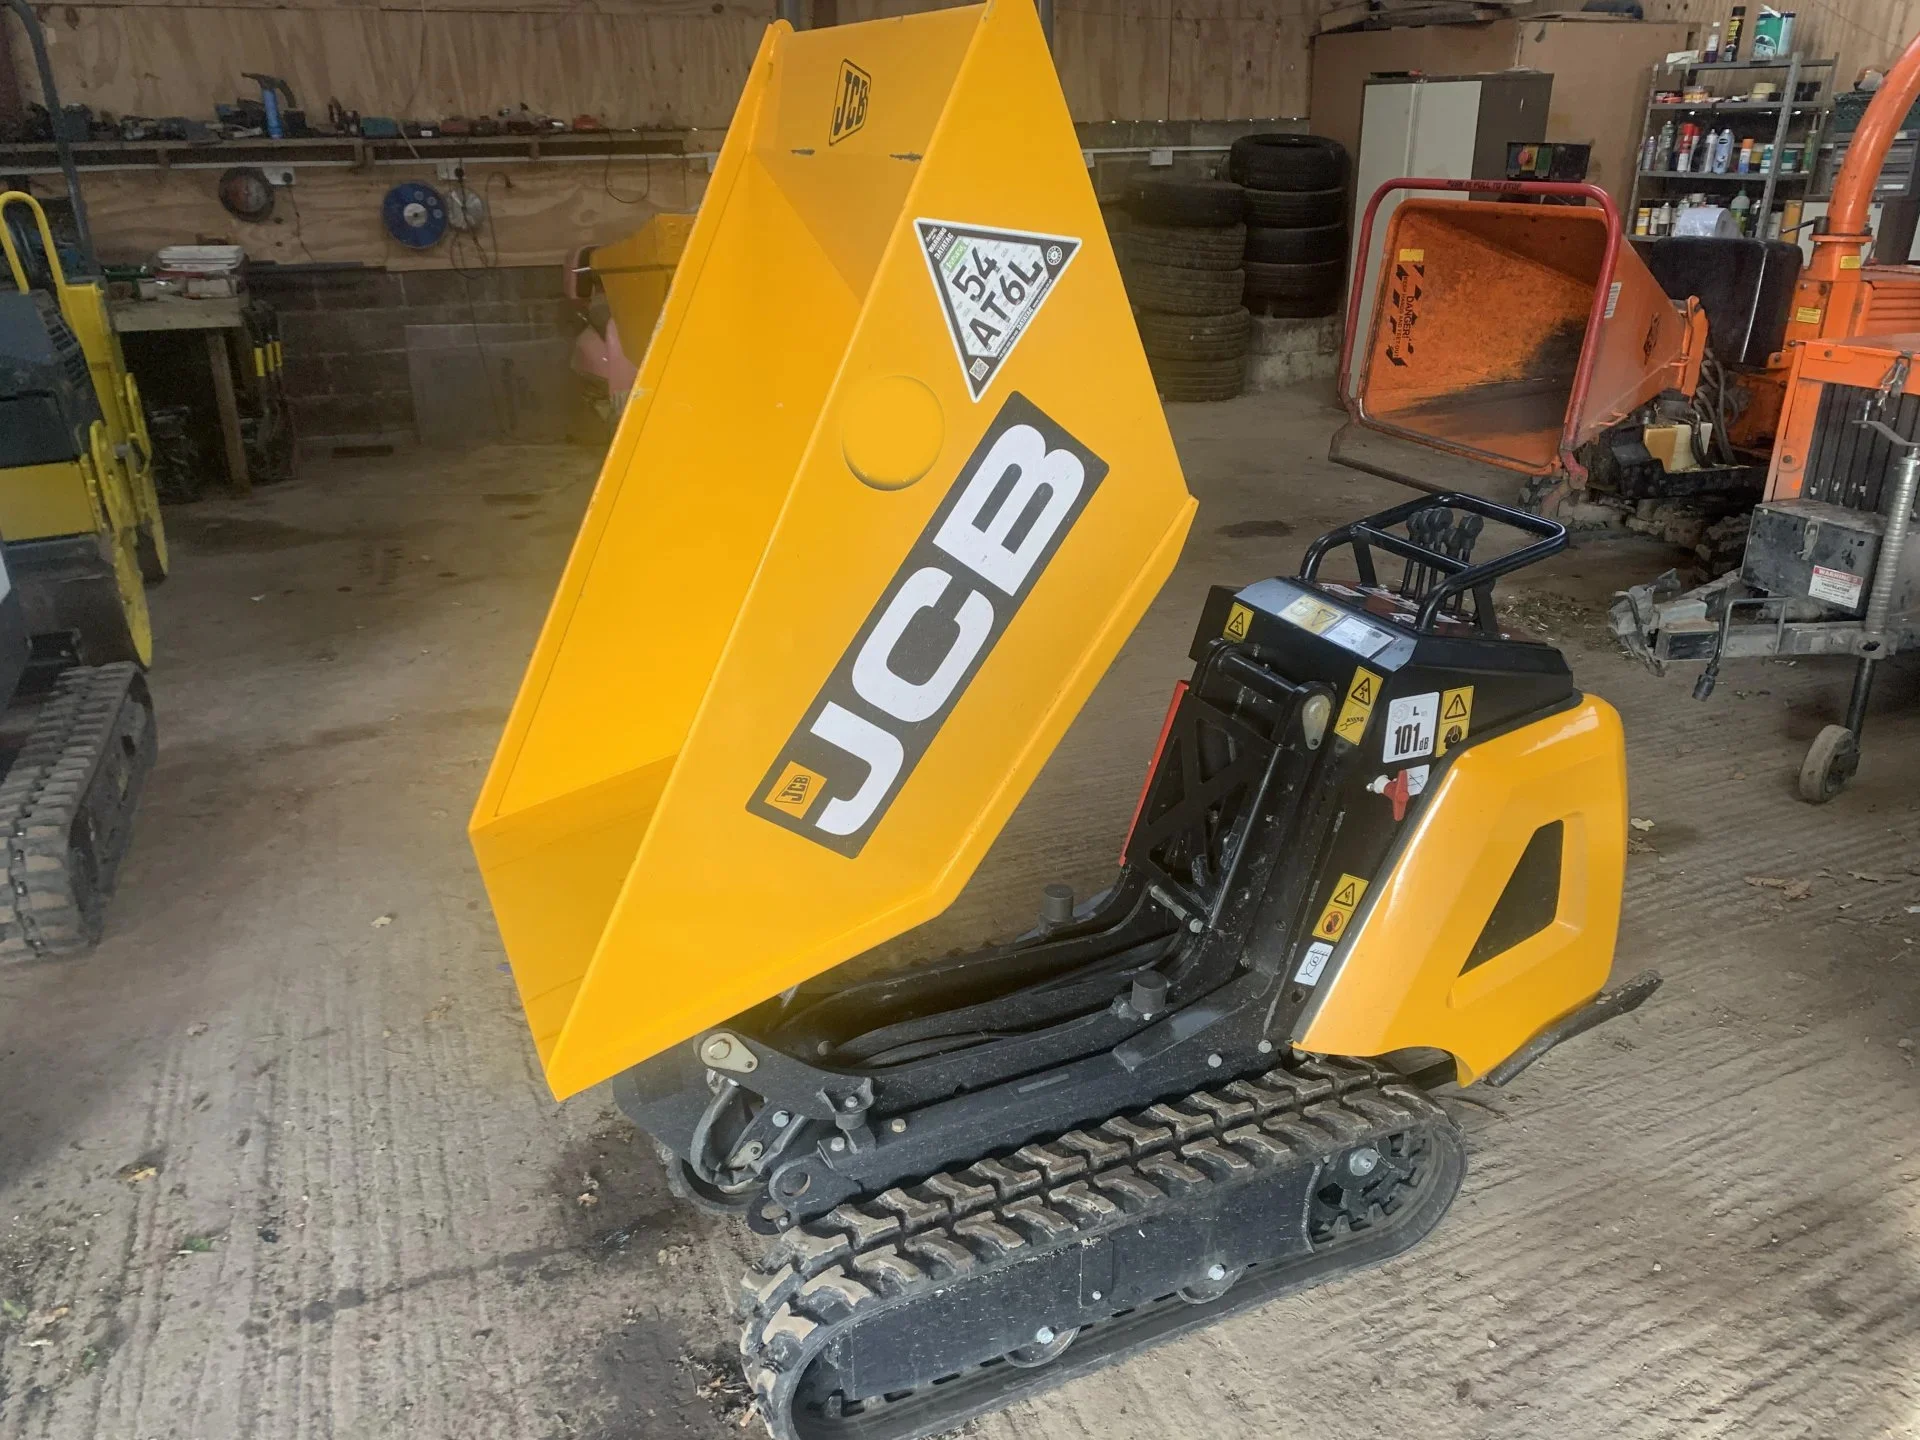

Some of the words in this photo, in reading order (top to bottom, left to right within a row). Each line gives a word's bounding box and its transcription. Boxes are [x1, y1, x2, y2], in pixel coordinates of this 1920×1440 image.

[833, 69, 868, 136] JCB
[928, 227, 947, 253] WARNING
[934, 233, 954, 260] DATATAG
[952, 247, 999, 302] 54
[969, 261, 1043, 351] AT6L
[810, 424, 1085, 836] JCB
[1394, 722, 1421, 755] 101
[1420, 737, 1430, 751] dB
[780, 777, 809, 802] JCB
